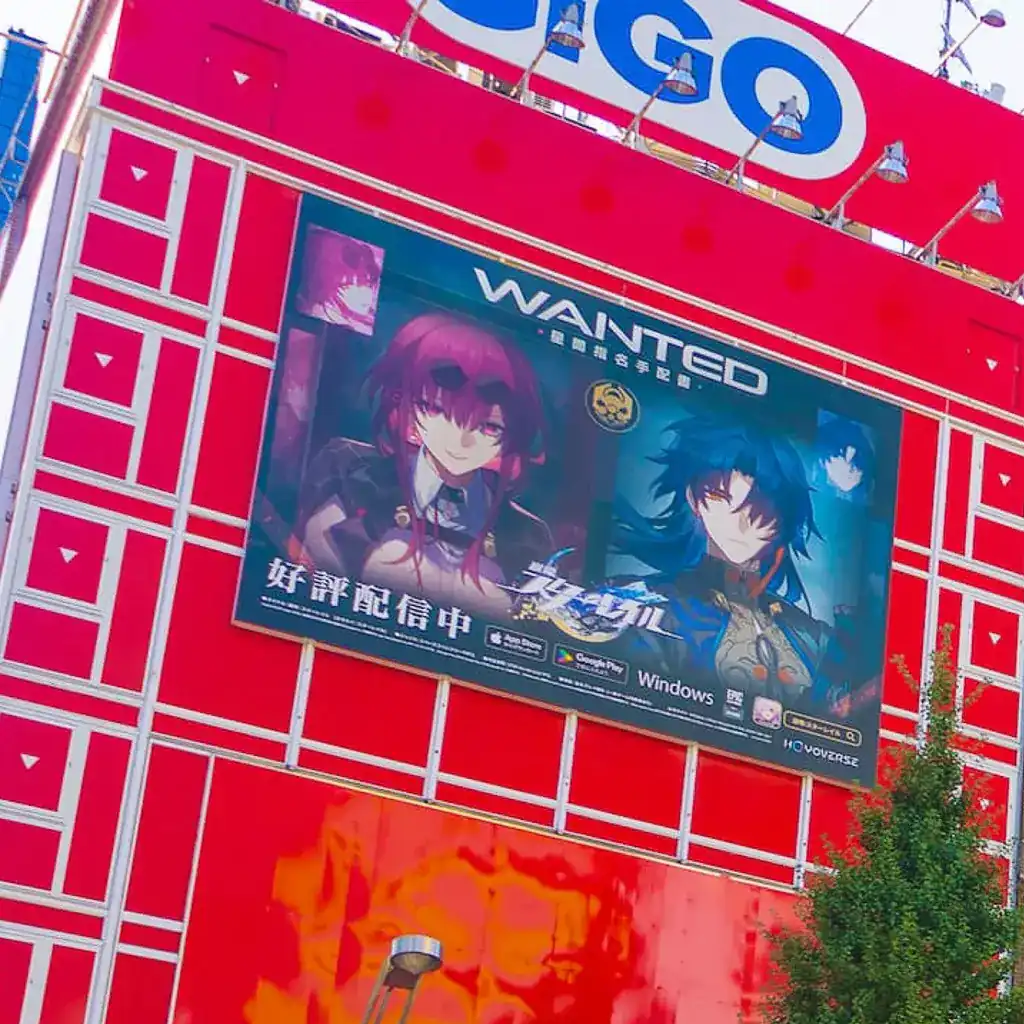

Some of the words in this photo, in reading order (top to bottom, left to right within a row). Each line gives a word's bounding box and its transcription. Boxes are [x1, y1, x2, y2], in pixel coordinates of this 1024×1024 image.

[432, 0, 842, 155] GO
[473, 267, 769, 396] WANTED
[265, 556, 474, 640] 好評配信中
[574, 652, 602, 670] Google
[637, 669, 715, 707] Windows
